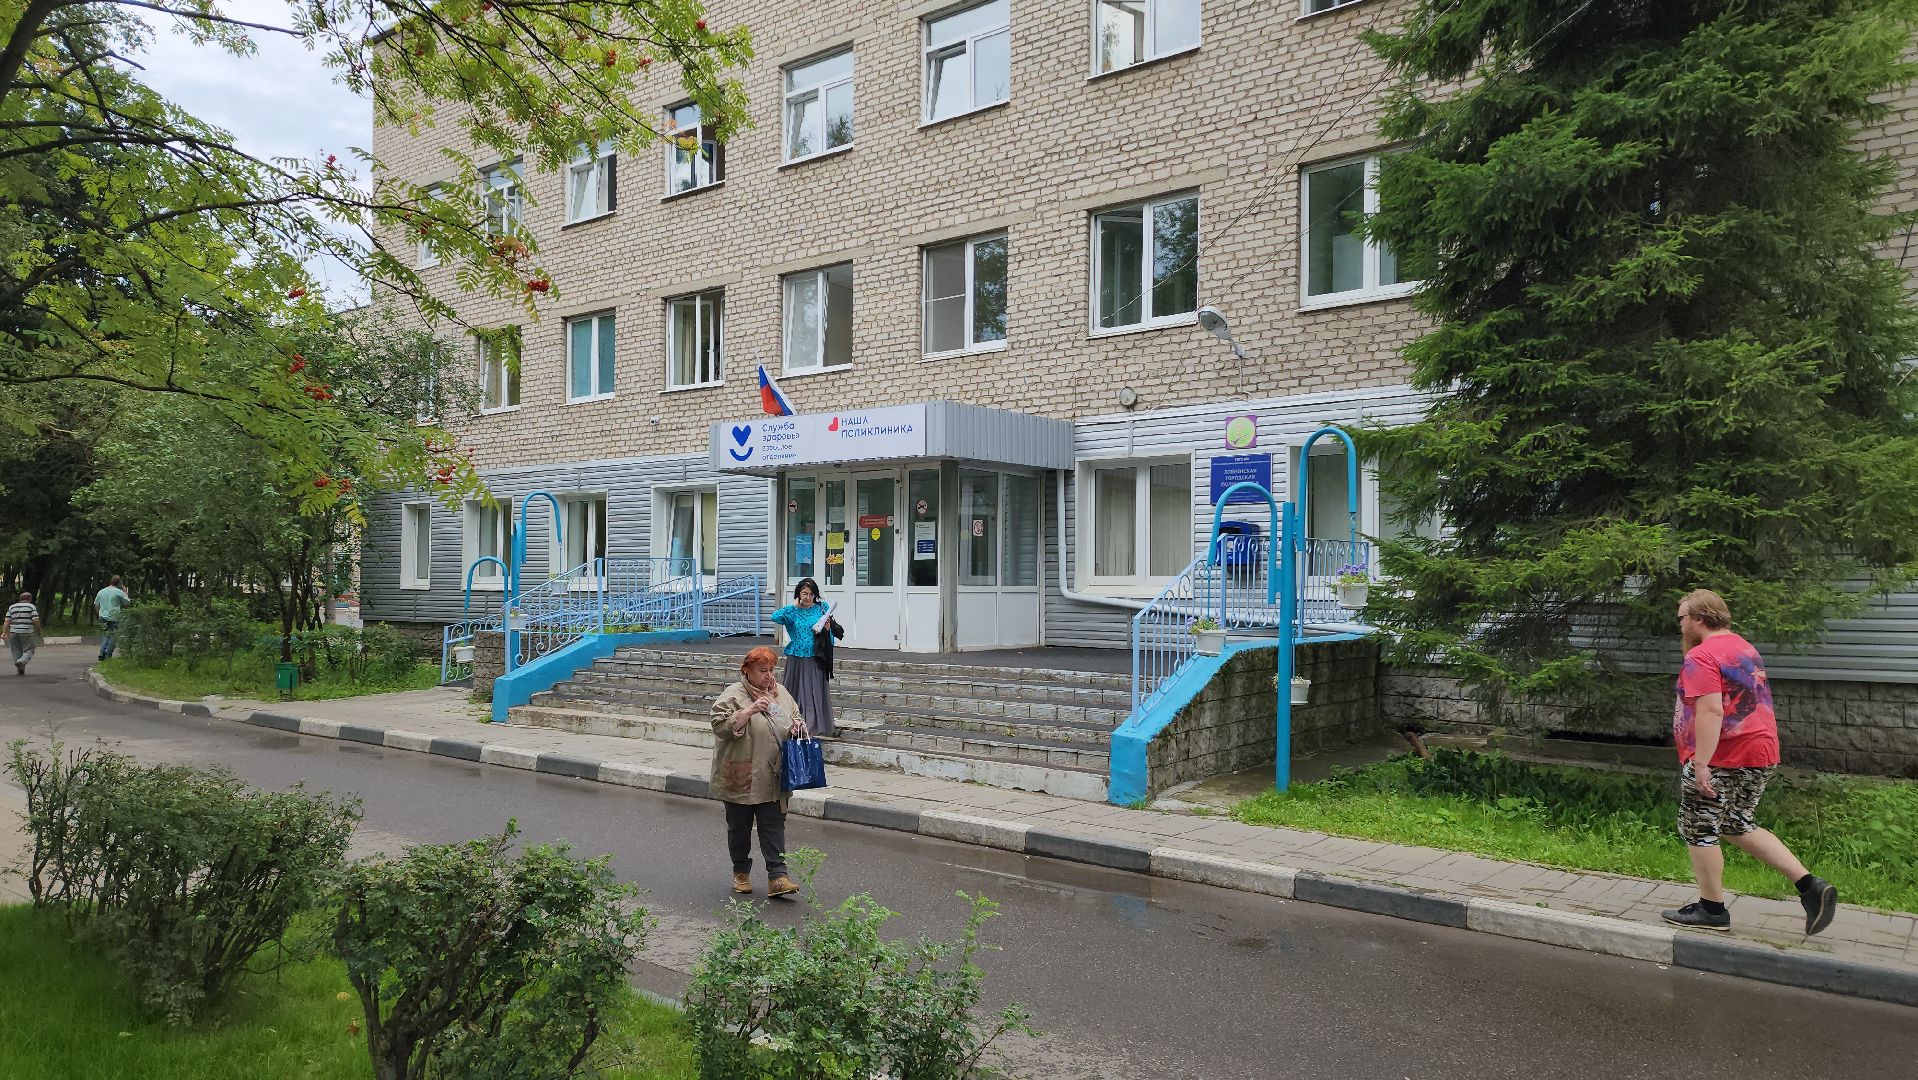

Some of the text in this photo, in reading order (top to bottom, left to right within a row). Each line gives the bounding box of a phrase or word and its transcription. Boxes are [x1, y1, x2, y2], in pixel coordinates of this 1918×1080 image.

[841, 416, 868, 426] НАША
[762, 421, 795, 433] Служба
[841, 424, 913, 438] ПОЛИКЛИНИКА
[762, 432, 800, 442] здоровья
